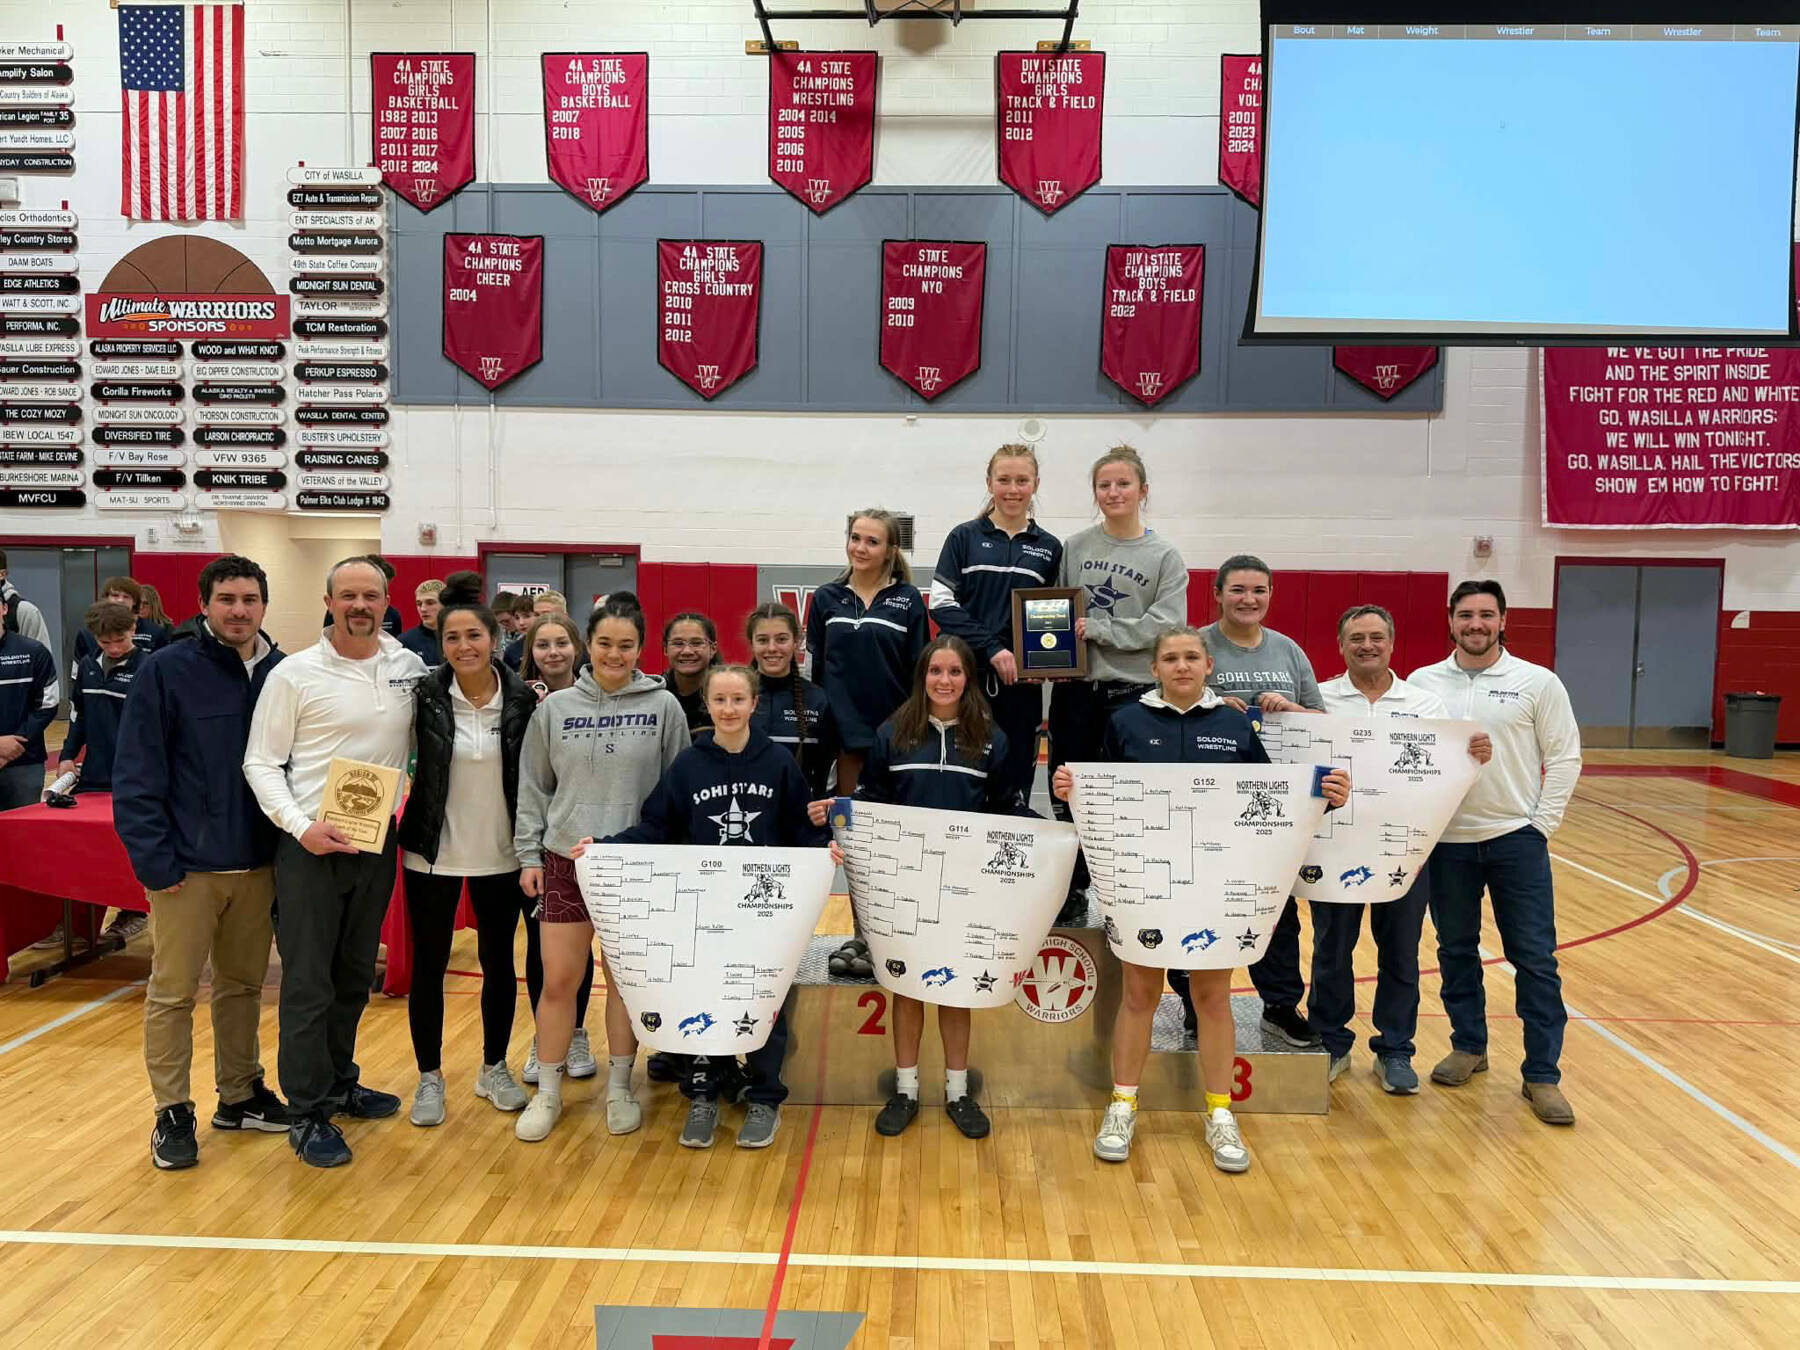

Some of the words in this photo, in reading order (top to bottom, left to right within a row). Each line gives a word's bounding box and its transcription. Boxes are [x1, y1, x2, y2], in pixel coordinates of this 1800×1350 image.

[1293, 26, 1315, 35] Bout
[1405, 26, 1439, 36] Weight
[1496, 26, 1534, 36] Wrestler
[1585, 27, 1611, 36] Team
[1663, 27, 1702, 36] Wrestler
[1754, 28, 1781, 37] Team
[18, 46, 65, 55] Mechanical
[397, 59, 411, 72] 4A
[421, 60, 450, 73] STATE
[797, 62, 811, 75] 4A
[821, 62, 851, 75] STATE
[1048, 59, 1082, 71] STATE
[30, 68, 54, 78] Salon
[393, 72, 454, 85] CHAMPIONS
[1020, 72, 1083, 84] CHAMPIONS
[793, 77, 854, 90] CHAMPIONS
[1035, 84, 1068, 96] GIRLS
[408, 84, 440, 97] GIRLS
[388, 96, 459, 109] BASKETBALL
[793, 93, 854, 106] WRESTLING
[1006, 96, 1042, 108] TRACK
[1063, 96, 1096, 109] FIELD
[380, 111, 407, 124] 1982
[411, 112, 438, 124] 2013
[778, 109, 805, 122] 2004
[810, 110, 837, 123] 2014
[1006, 110, 1033, 124] 2011
[380, 127, 407, 140] 2007
[411, 128, 438, 140] 2016
[778, 126, 805, 139] 2005
[1005, 127, 1033, 141] 2012
[380, 144, 407, 157] 2011
[411, 144, 438, 157] 2017
[777, 143, 804, 156] 2006
[380, 160, 407, 173] 2012
[411, 160, 438, 173] 2024
[776, 160, 804, 172] 2010
[305, 171, 321, 179] CITY
[333, 171, 363, 180] WASILLA
[19, 212, 72, 222] Orthodontics
[14, 234, 45, 245] Country
[47, 234, 72, 243] Stores
[293, 236, 315, 245] Motto
[317, 236, 352, 247] Mortgage
[354, 236, 378, 246] Aurora
[468, 242, 482, 255] 4A
[490, 243, 520, 256] STATE
[683, 246, 697, 259] 4A
[706, 246, 736, 260] STATE
[918, 249, 948, 263] STATE
[464, 257, 522, 271] CHAMPIONS
[679, 258, 740, 272] CHAMPIONS
[694, 271, 726, 284] GIRLS
[903, 264, 963, 278] CHAMPIONS
[3, 279, 22, 288] EDGE
[24, 279, 60, 288] ATHLETICS
[296, 281, 330, 290] MIDNIGHT
[350, 281, 377, 290] DENTAL
[477, 272, 510, 287] CHEER
[665, 281, 700, 295] CROSS
[705, 283, 754, 296] COUNTRY
[921, 281, 943, 294] NYO
[449, 289, 477, 302] 2004
[100, 296, 167, 322] Ultimate
[168, 301, 276, 320] WARRIORS
[300, 301, 337, 310] TAYLOR
[665, 296, 692, 309] 2010
[888, 297, 915, 310] 2009
[665, 313, 692, 326] 2011
[887, 314, 914, 327] 2010
[149, 321, 226, 332] SPONSORS
[305, 323, 325, 332] TCM
[328, 323, 377, 332] Restoration
[665, 329, 692, 342] 2012
[199, 346, 222, 354] WOOD
[224, 345, 236, 354] and
[238, 345, 258, 355] WHAT
[259, 346, 278, 355] KNOT
[231, 367, 279, 376] CONSTRUCTION
[305, 368, 335, 377] PERKUP
[337, 368, 377, 377] ESPRESSO
[1605, 365, 1635, 381] AND
[1639, 365, 1669, 381] THE
[1674, 364, 1720, 381] SPIRIT
[1725, 364, 1771, 380] INSIDE
[102, 387, 128, 396] Gorilla
[131, 387, 172, 396] Fireworks
[299, 389, 330, 397] Hatcher
[333, 389, 353, 397] Pass
[356, 389, 383, 398] Polaris
[1569, 386, 1613, 403] FIGHT
[1618, 387, 1649, 403] FOR
[1653, 387, 1683, 403] THE
[1687, 387, 1717, 403] RED
[1722, 386, 1749, 402] AND
[1754, 386, 1800, 402] WHITE
[5, 409, 19, 418] THE
[21, 409, 43, 418] COZY
[44, 409, 67, 419] MOZY
[361, 412, 385, 420] CENTER
[1628, 410, 1693, 426] WASILLA
[3, 431, 25, 440] IBEW
[27, 431, 54, 440] LOCAL
[57, 431, 74, 440] 1547
[104, 431, 153, 441] DIVERSIFIED
[155, 431, 172, 441] TIRE
[1606, 432, 1628, 448] WE
[1633, 432, 1670, 448] WILL
[1674, 432, 1700, 448] WIN
[1704, 431, 1771, 447] TONIGHT.
[213, 454, 237, 462] VFW
[241, 454, 267, 462] 9365
[304, 455, 343, 464] RAISING
[346, 455, 379, 465] CANES
[212, 475, 236, 484] KNIK
[239, 475, 268, 484] TRIBE
[18, 494, 57, 503] MVFCU
[1111, 563, 1150, 587] STARS
[1216, 671, 1251, 684] SOHI
[563, 713, 657, 730] SOLDOTNA
[1196, 736, 1238, 745] SOLDOTNA
[1389, 733, 1417, 742] NORTHERN
[1417, 733, 1436, 742] LIGHTS
[1388, 768, 1441, 776] CHAMPIONSHIPS
[1193, 778, 1216, 786] G152
[1236, 781, 1268, 790] NORTHERN
[1268, 781, 1289, 790] LIGHTS
[693, 784, 728, 805] SOHI
[949, 825, 969, 833] G114
[1234, 820, 1293, 828] CHAMPIONSHIPS
[987, 831, 1015, 842] NORTHERN
[1015, 833, 1034, 843] LIGHTS
[701, 860, 723, 868] G100
[742, 863, 771, 873] NORTHERN
[772, 864, 791, 873] LIGHTS
[980, 868, 1036, 879] CHAMPIONSHIPS
[737, 902, 794, 910] CHAMPIONSHIPS
[1042, 938, 1067, 948] HIGH
[1068, 943, 1096, 978] SCHOOL
[857, 990, 888, 1034] 2
[1025, 1003, 1084, 1021] WARRIORS
[1230, 1056, 1253, 1102] 3
